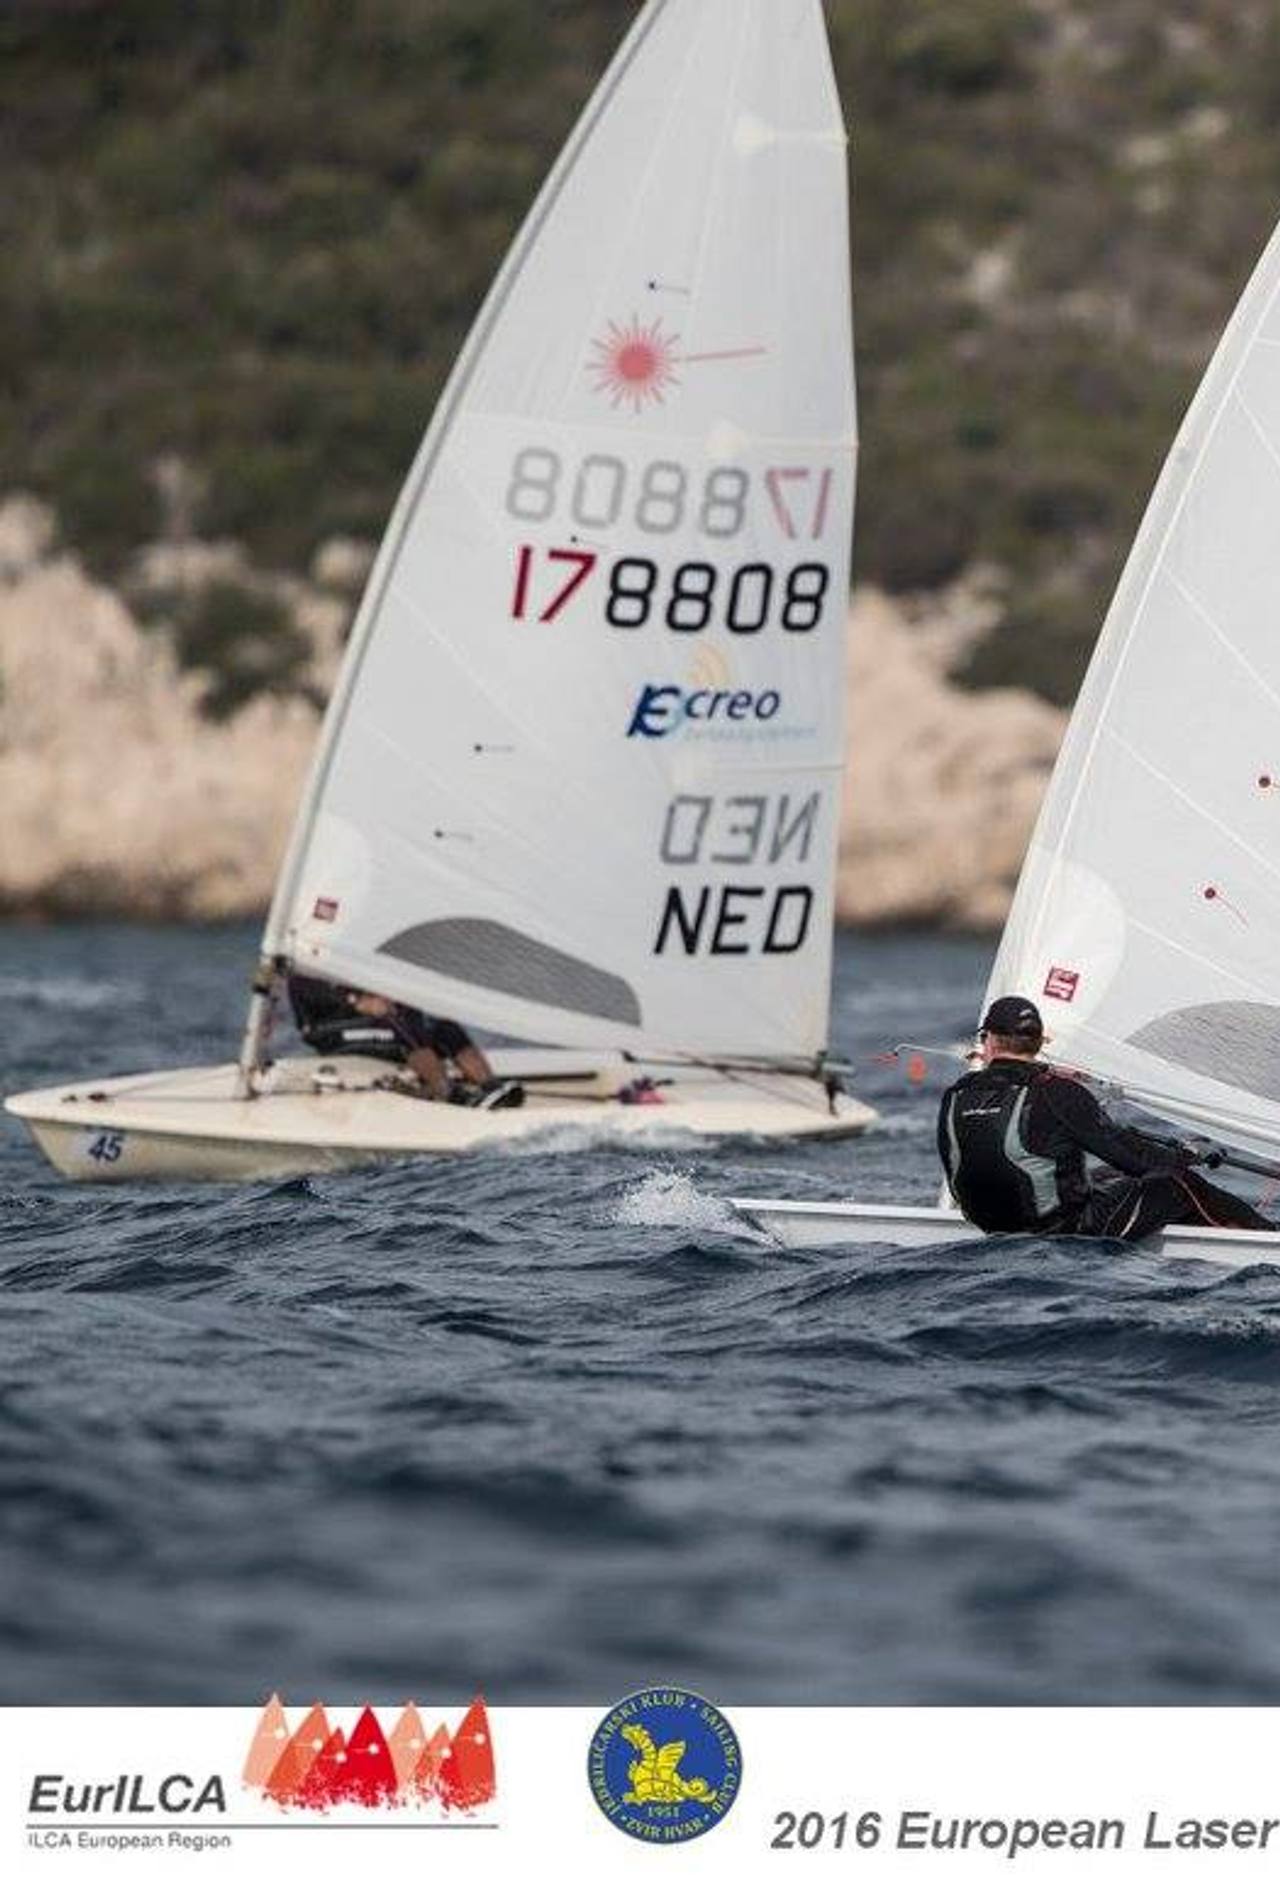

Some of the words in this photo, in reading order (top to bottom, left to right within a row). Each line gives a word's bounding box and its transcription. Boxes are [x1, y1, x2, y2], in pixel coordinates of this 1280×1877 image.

[511, 546, 829, 634] 178808
[653, 886, 815, 955] NED
[88, 1136, 125, 1161] 45
